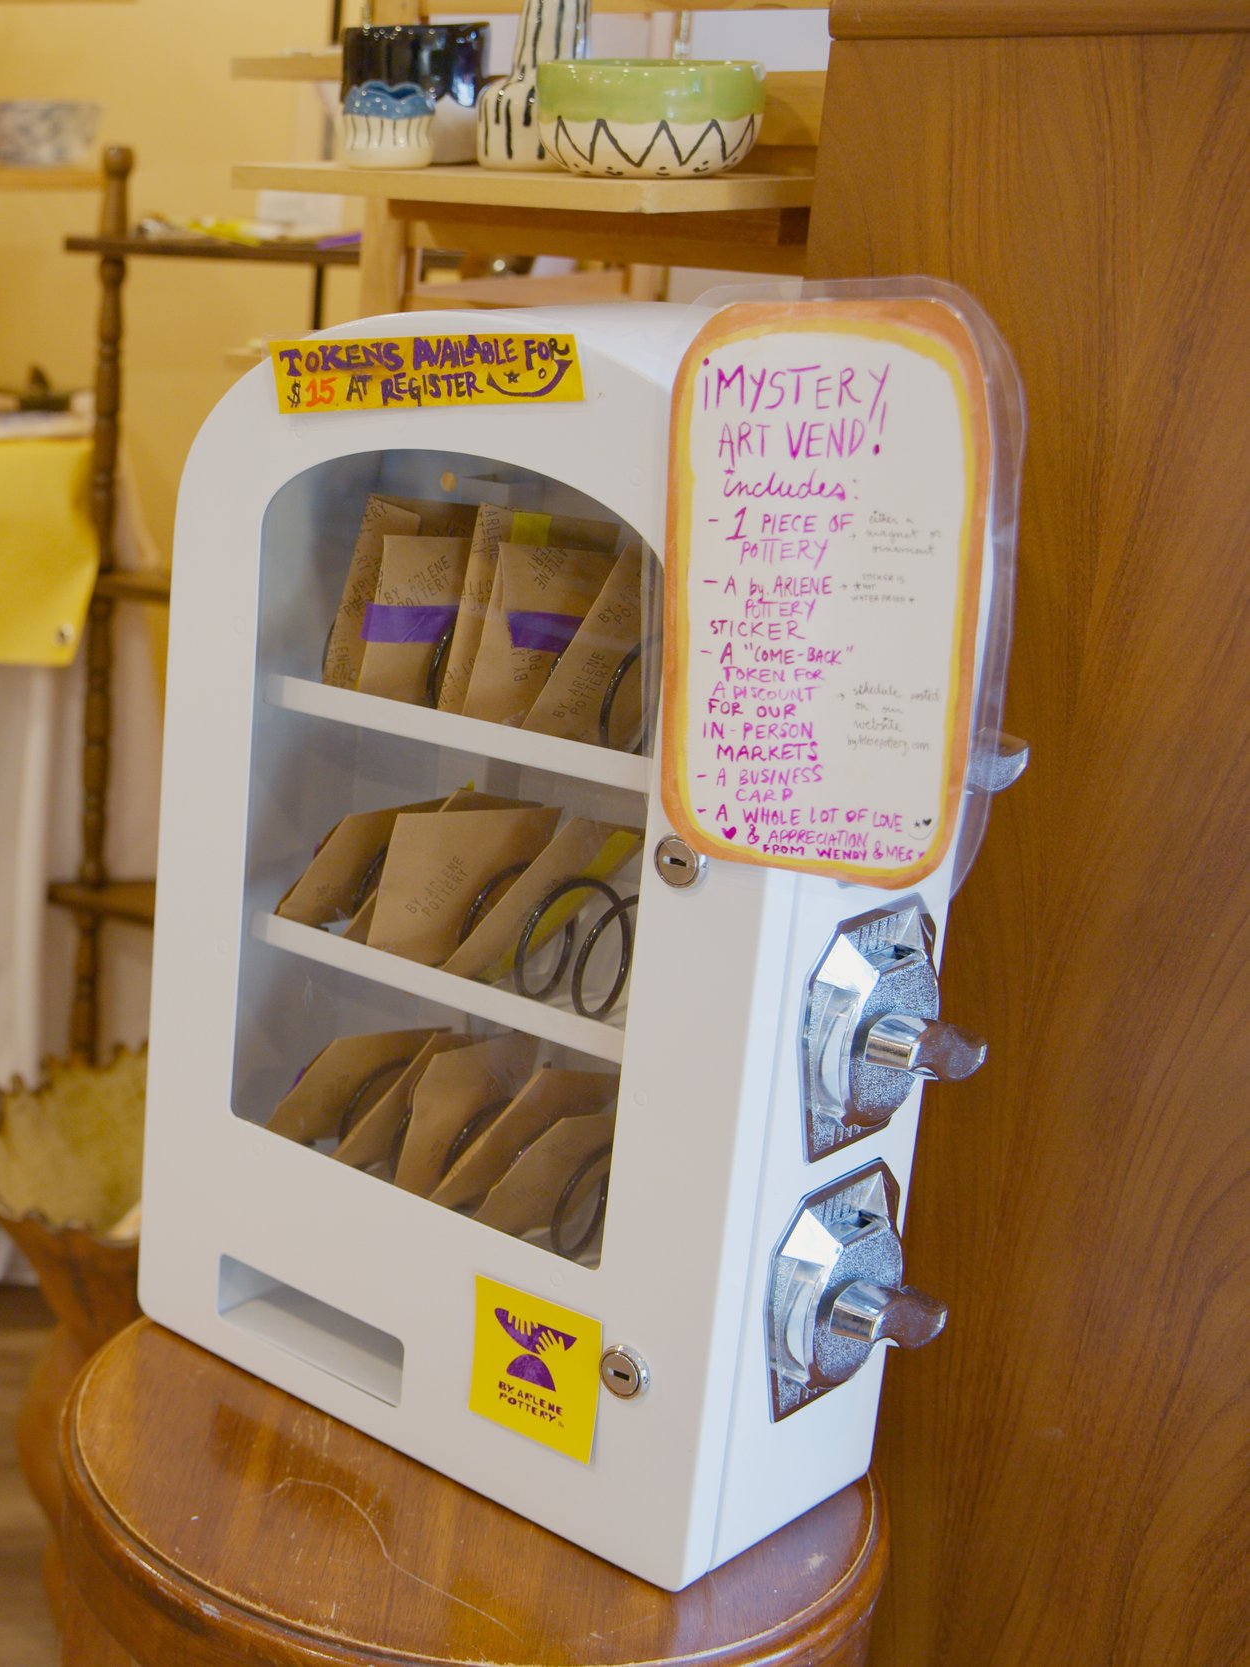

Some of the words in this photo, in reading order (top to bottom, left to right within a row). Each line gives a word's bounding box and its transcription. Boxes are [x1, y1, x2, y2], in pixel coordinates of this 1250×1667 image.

[279, 342, 405, 377] TOKENS
[413, 334, 518, 371] AVAILABLE
[523, 337, 570, 371] FOR
[346, 374, 372, 402] AT
[381, 371, 485, 407] REGISTER
[718, 421, 772, 467] ART
[725, 506, 748, 540] 1
[761, 513, 817, 534] PIECE
[829, 512, 855, 533] OF
[740, 537, 830, 570] POTTERY
[723, 575, 738, 595] A
[773, 576, 833, 596] ARLENE
[745, 598, 817, 622] POTTERY
[710, 620, 806, 641] STICKER
[720, 642, 734, 666] A
[722, 665, 786, 683] TOKEN
[794, 667, 826, 683] FOR
[712, 681, 727, 700] A
[733, 685, 822, 703] DISCOUNT
[707, 698, 745, 716] FOR
[756, 703, 798, 719] OUR
[702, 721, 814, 742] IN-PERSON
[716, 741, 819, 763] MARKETS
[716, 769, 727, 788] A
[739, 765, 823, 787] BUSINESS
[715, 804, 729, 822] A
[742, 806, 801, 826] WHOLE
[845, 808, 869, 824] OF
[872, 811, 903, 833] LOVE
[767, 829, 870, 849] APPRECIATION
[762, 843, 806, 857] FROM
[816, 847, 868, 861] WENDY
[517, 1389, 563, 1417] ARLENE
